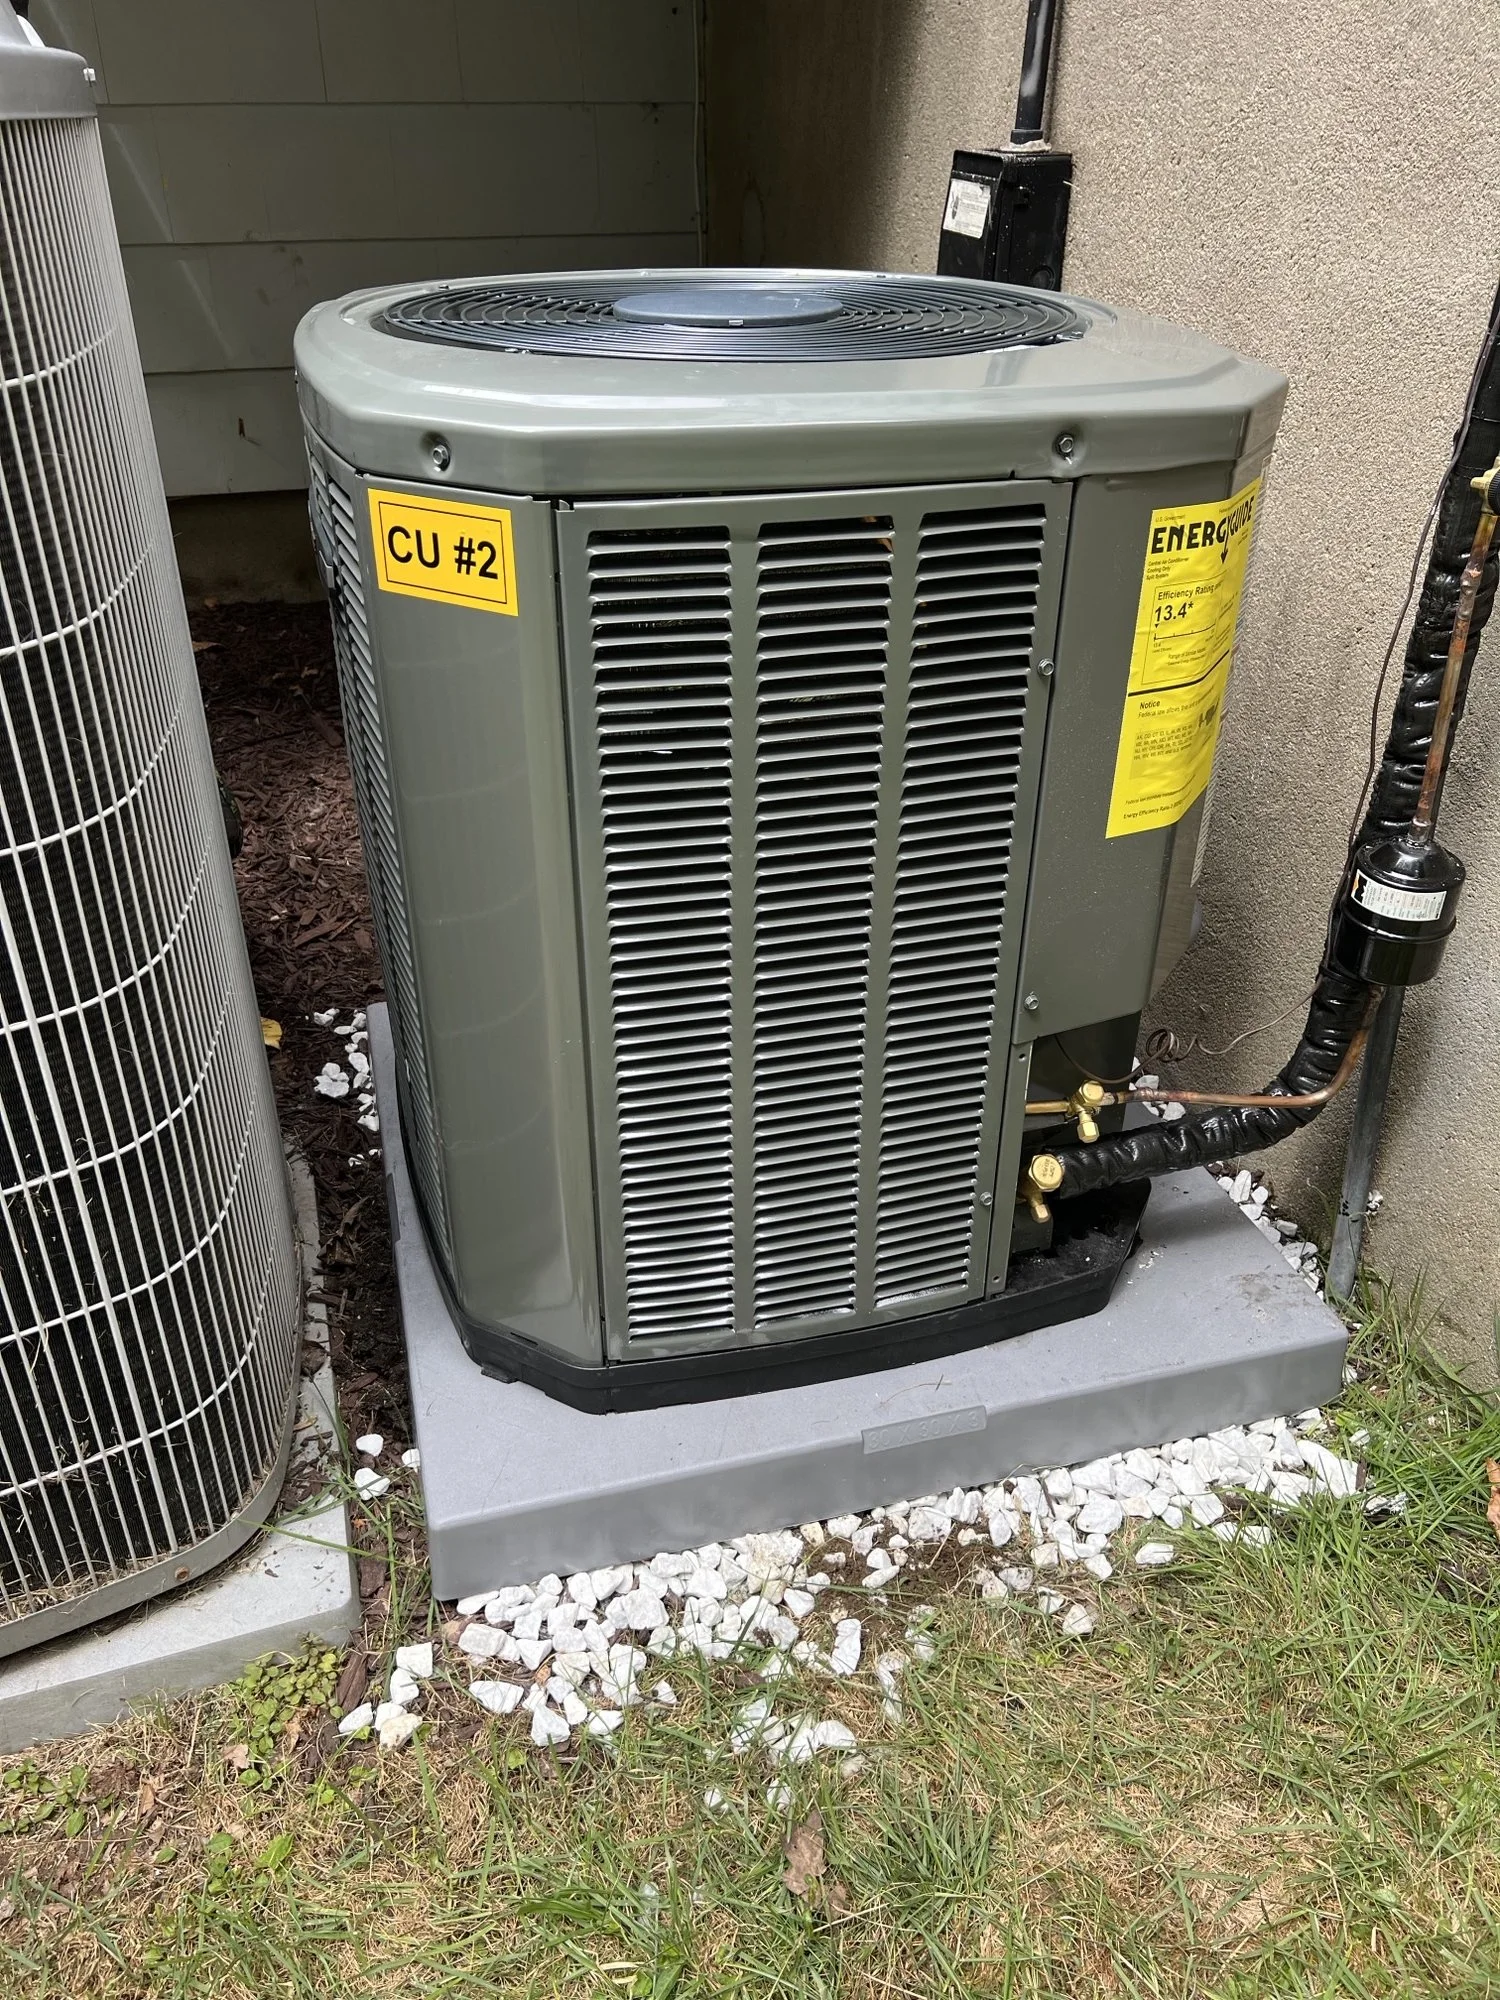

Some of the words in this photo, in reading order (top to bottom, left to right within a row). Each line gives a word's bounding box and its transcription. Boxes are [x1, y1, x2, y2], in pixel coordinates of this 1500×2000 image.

[387, 525, 440, 569] CU
[454, 536, 499, 580] #2
[1157, 588, 1194, 600] Efficiency
[1194, 583, 1215, 595] Rating
[1139, 699, 1161, 710] Notice
[1123, 812, 1139, 820] Energy
[1139, 807, 1160, 817] Efficiency
